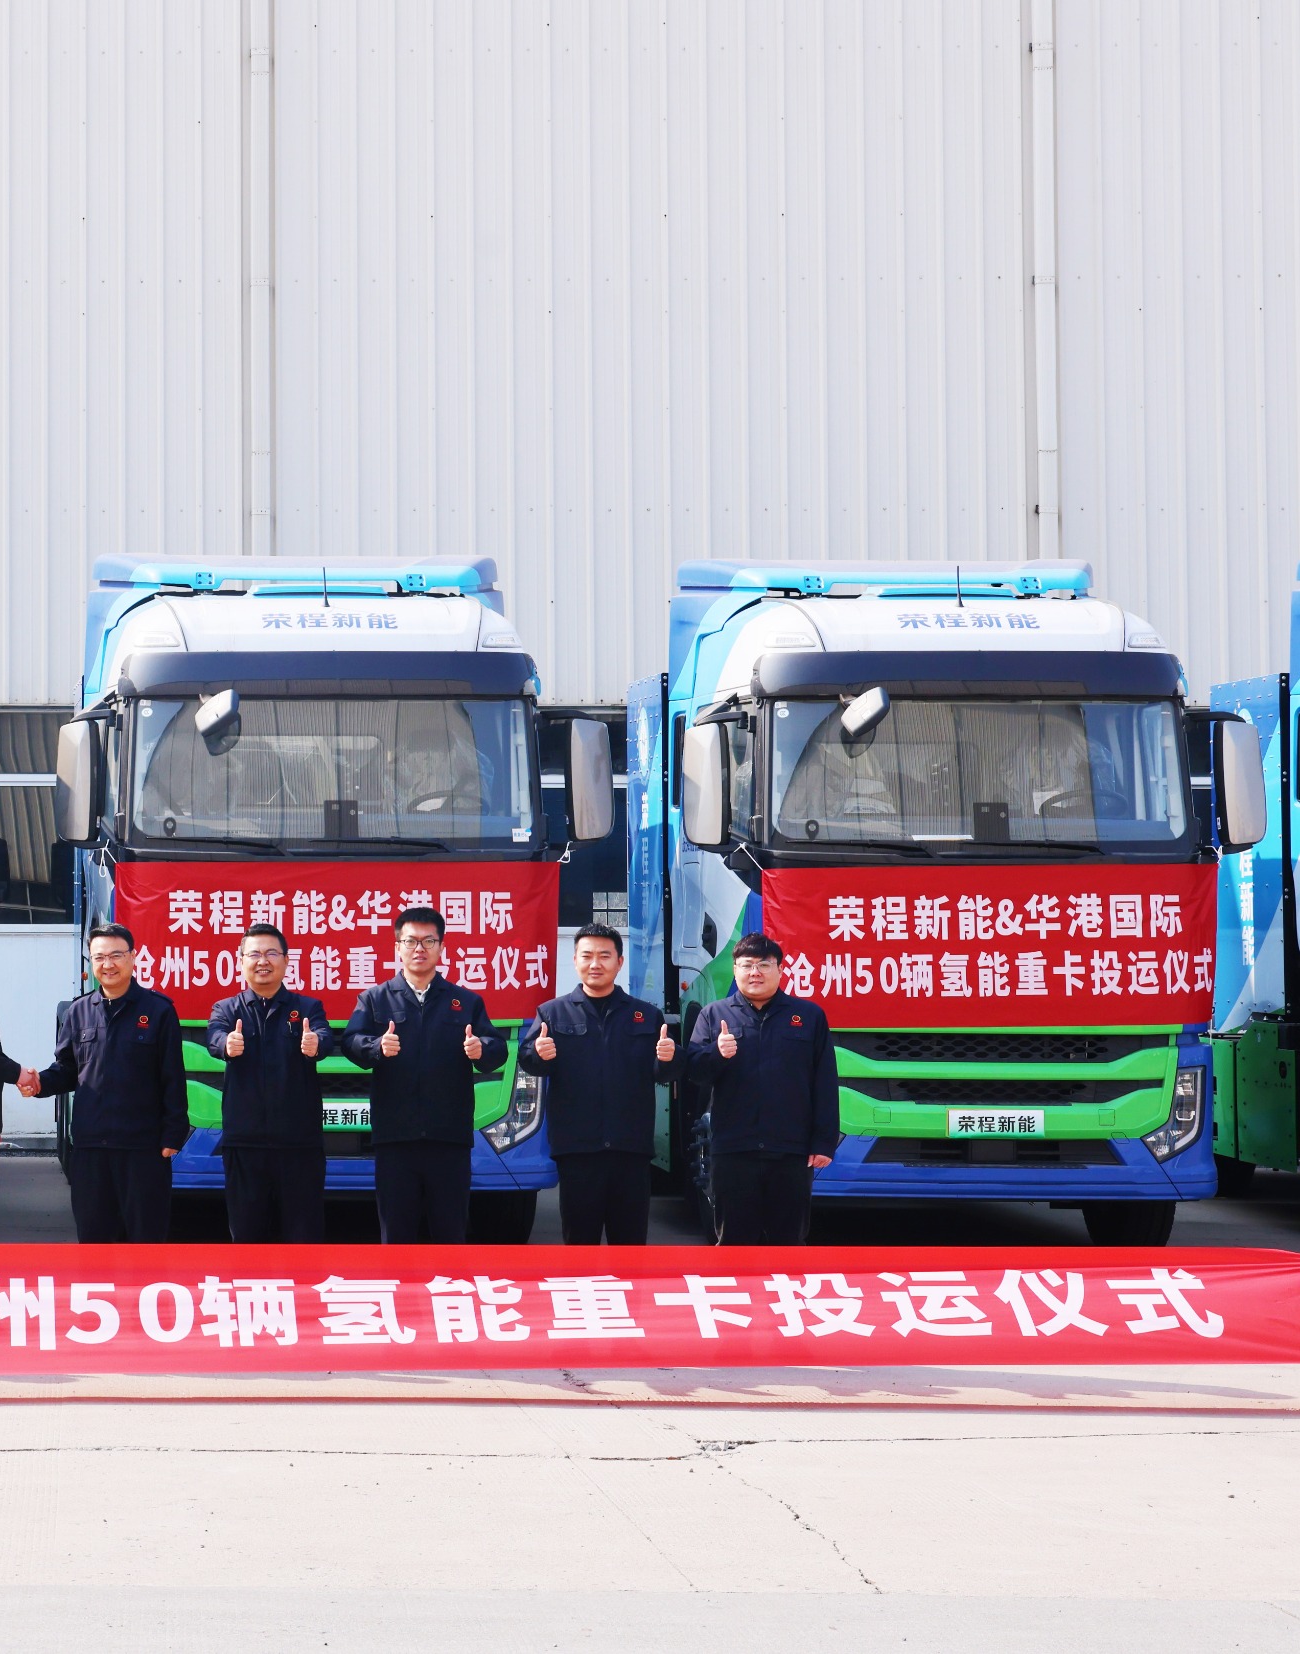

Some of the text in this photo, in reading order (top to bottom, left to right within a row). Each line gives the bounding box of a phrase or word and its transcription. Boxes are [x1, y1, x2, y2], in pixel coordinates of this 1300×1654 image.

[261, 612, 399, 630] 荣程新能
[897, 612, 1041, 630] 荣程新能
[828, 893, 1183, 942] 荣程新能&华港国际
[1239, 850, 1255, 966] 程新能
[783, 949, 1214, 998] 沧州50辆氢能重卡投运仪式
[958, 1115, 1036, 1133] 荣程新能
